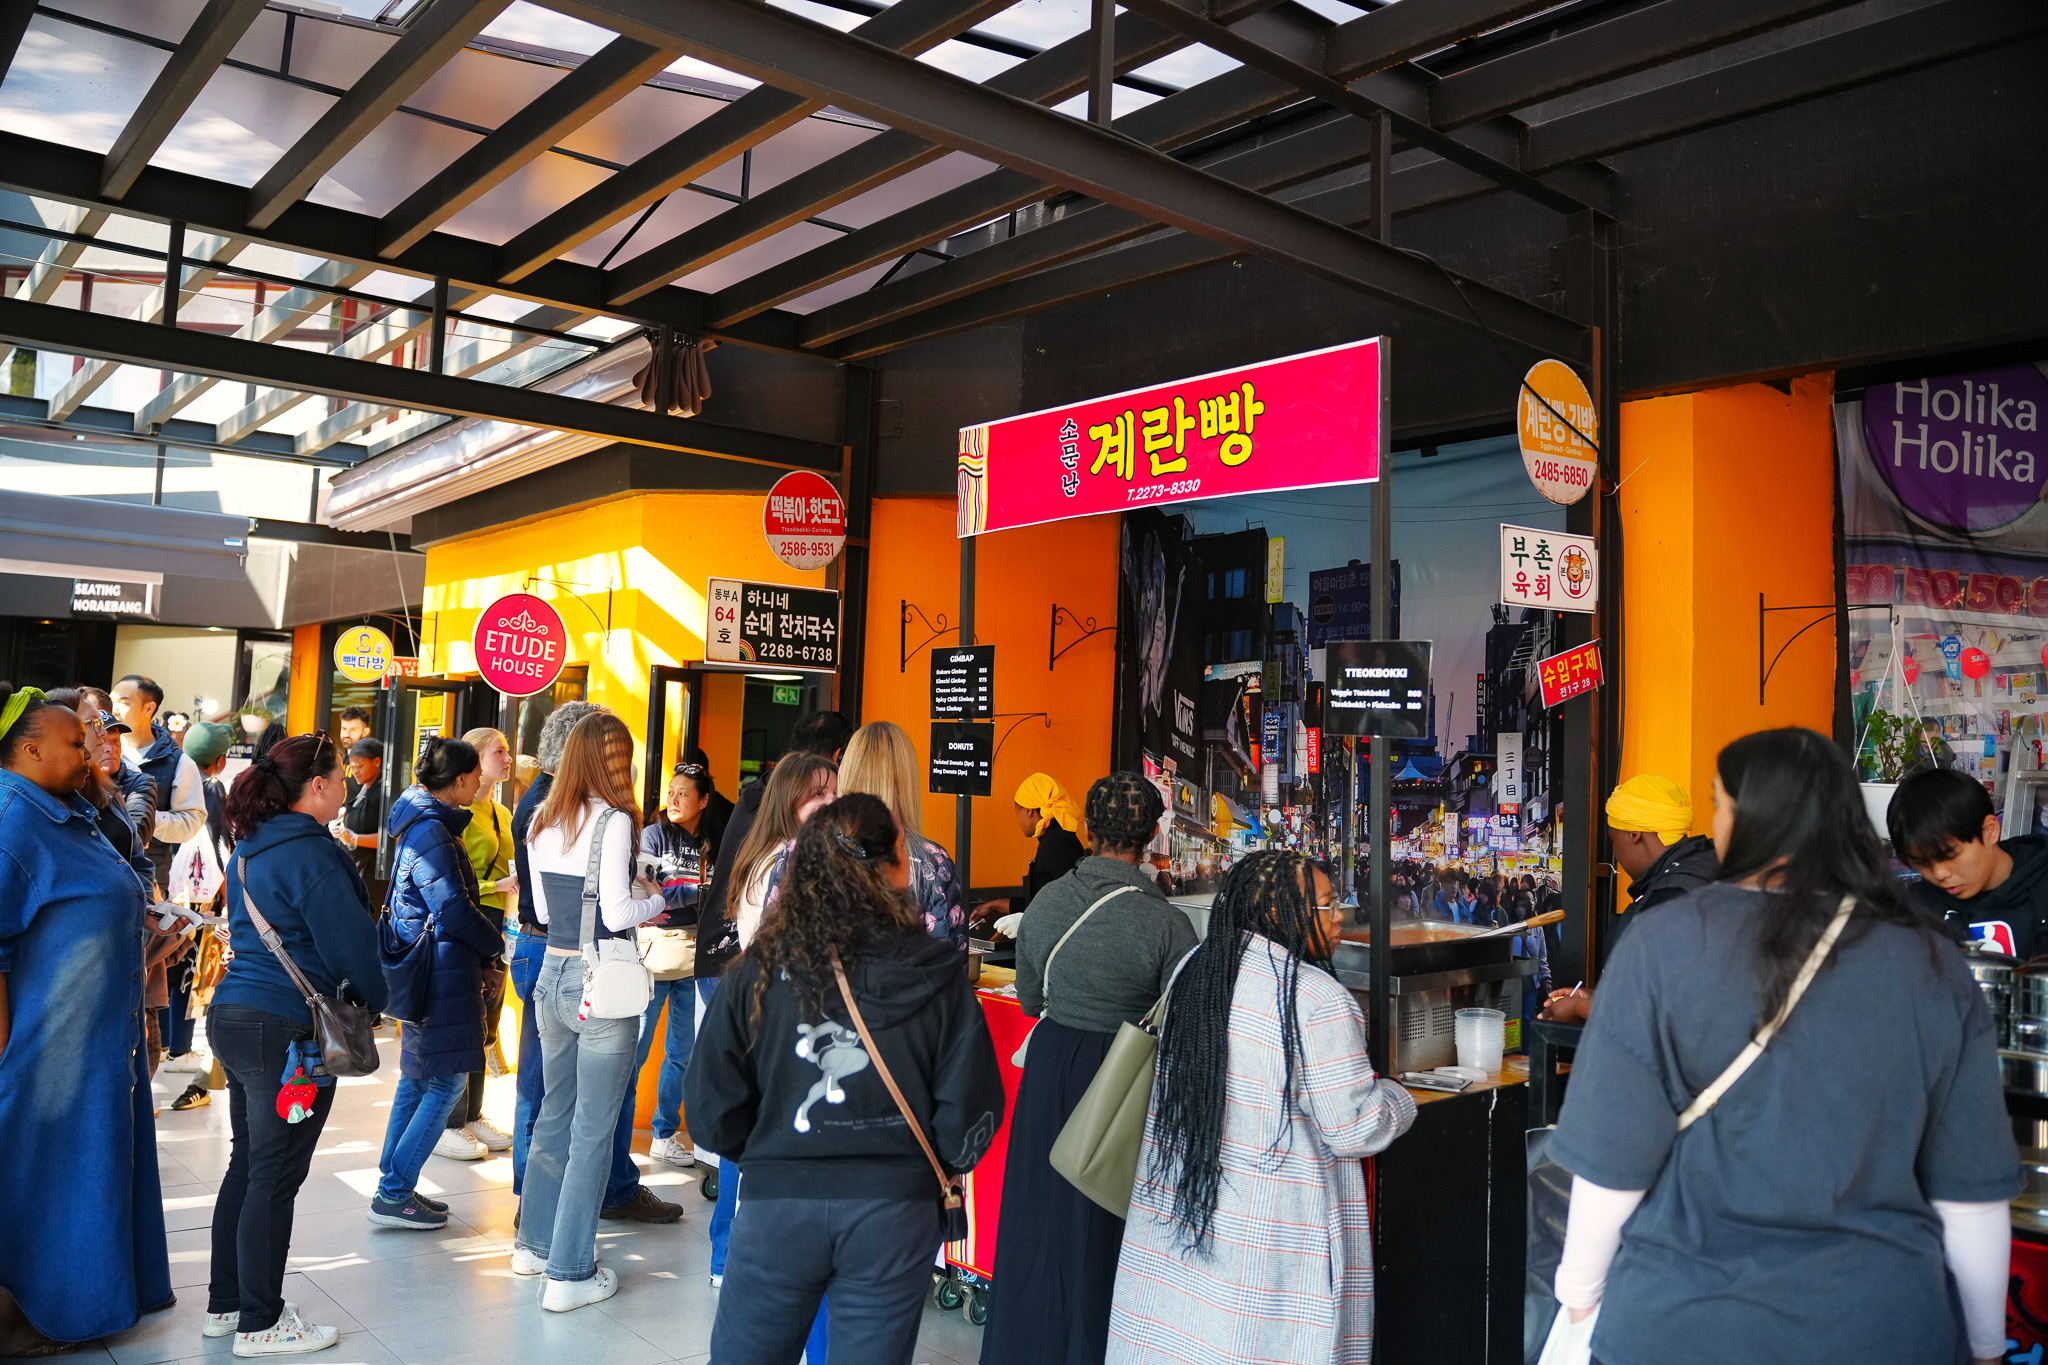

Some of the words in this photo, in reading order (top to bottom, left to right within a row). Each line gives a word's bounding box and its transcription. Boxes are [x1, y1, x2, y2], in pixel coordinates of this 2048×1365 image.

[1895, 378, 2037, 432] Holika
[1525, 393, 1566, 443] 계란빵
[1088, 381, 1265, 482] 계란빵
[1059, 418, 1080, 497] 소문난
[1892, 420, 2035, 483] Holika
[1535, 459, 1588, 487] 2485-6850
[1127, 478, 1201, 501] T.2273-8330
[780, 542, 834, 556] 2586-9531
[1510, 536, 1553, 571] 부촌
[74, 583, 121, 597] SEATING
[1512, 571, 1550, 601] 육회
[73, 599, 142, 614] NORAEBANG
[747, 590, 789, 610] 하니네
[715, 606, 735, 623] 64
[717, 628, 731, 644] 호
[744, 611, 774, 637] 순대
[779, 613, 836, 643] 잔치국수
[485, 629, 557, 662] ETUDE
[760, 642, 833, 662] 2268-6738
[1944, 645, 1959, 653] ADT
[342, 654, 386, 670] 빽다방
[491, 656, 544, 678] HOUSE
[950, 654, 975, 663] GIMBAP
[1544, 647, 1598, 689] 수입구제
[1903, 661, 1917, 672] SALE
[1971, 654, 1986, 663] SALE
[1345, 667, 1408, 678] TTEOKBOKKI
[1582, 677, 1591, 688] 28
[1331, 688, 1353, 698] Veggie
[1353, 688, 1390, 697] Tteokbokki
[1330, 700, 1366, 708] Tteokbokki
[1371, 701, 1401, 710] Fishcake
[949, 742, 973, 750] DONUTS
[1505, 752, 1516, 796] 三丁目
